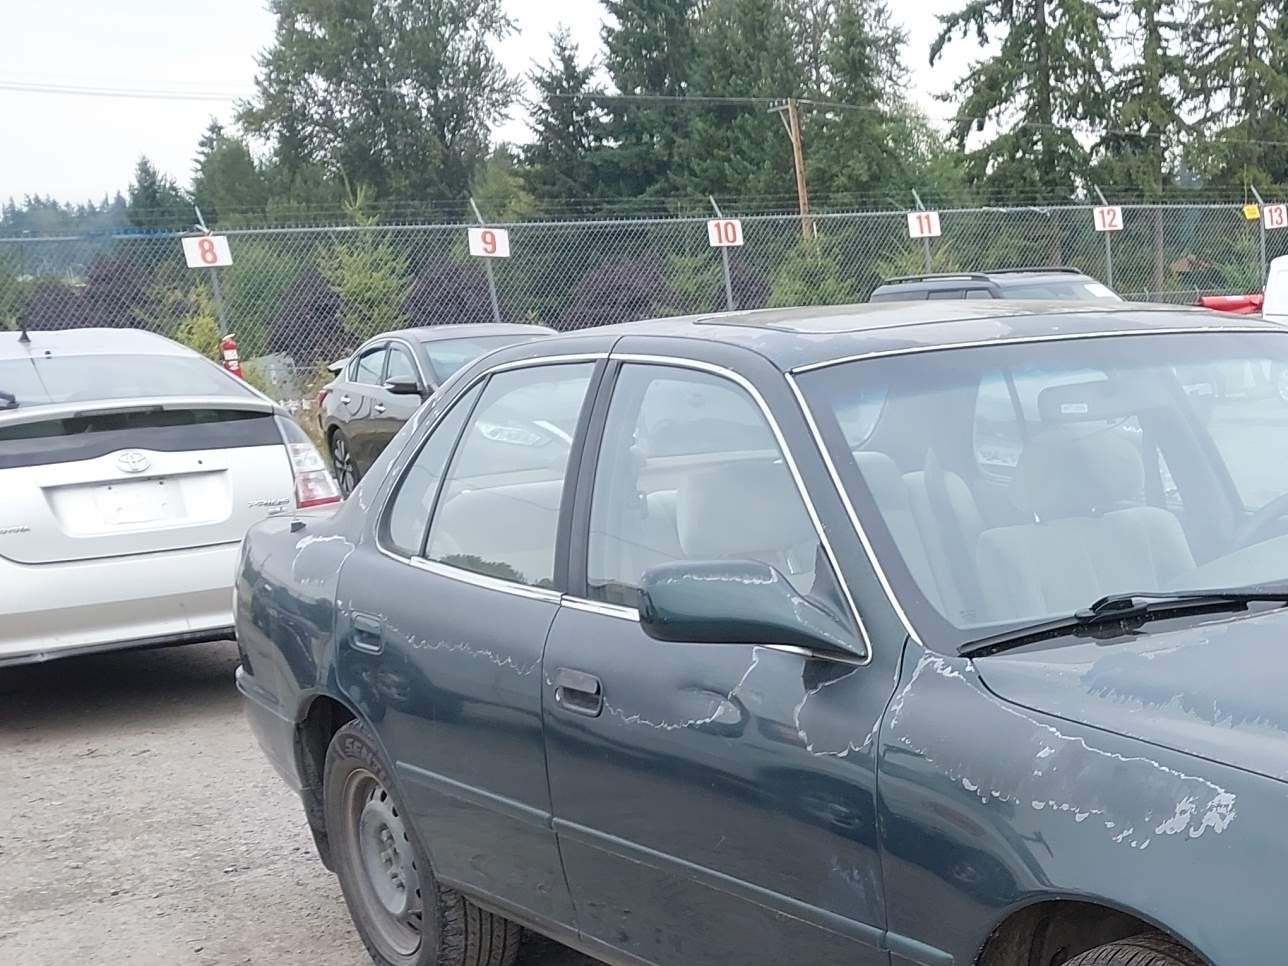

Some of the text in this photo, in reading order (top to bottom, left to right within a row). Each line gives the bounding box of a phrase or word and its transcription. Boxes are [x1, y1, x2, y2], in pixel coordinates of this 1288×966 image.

[915, 213, 934, 235] 11
[1099, 208, 1118, 229] 12
[1268, 207, 1284, 226] 13
[480, 230, 497, 255] 9
[713, 221, 738, 245] 10
[198, 238, 218, 265] 8
